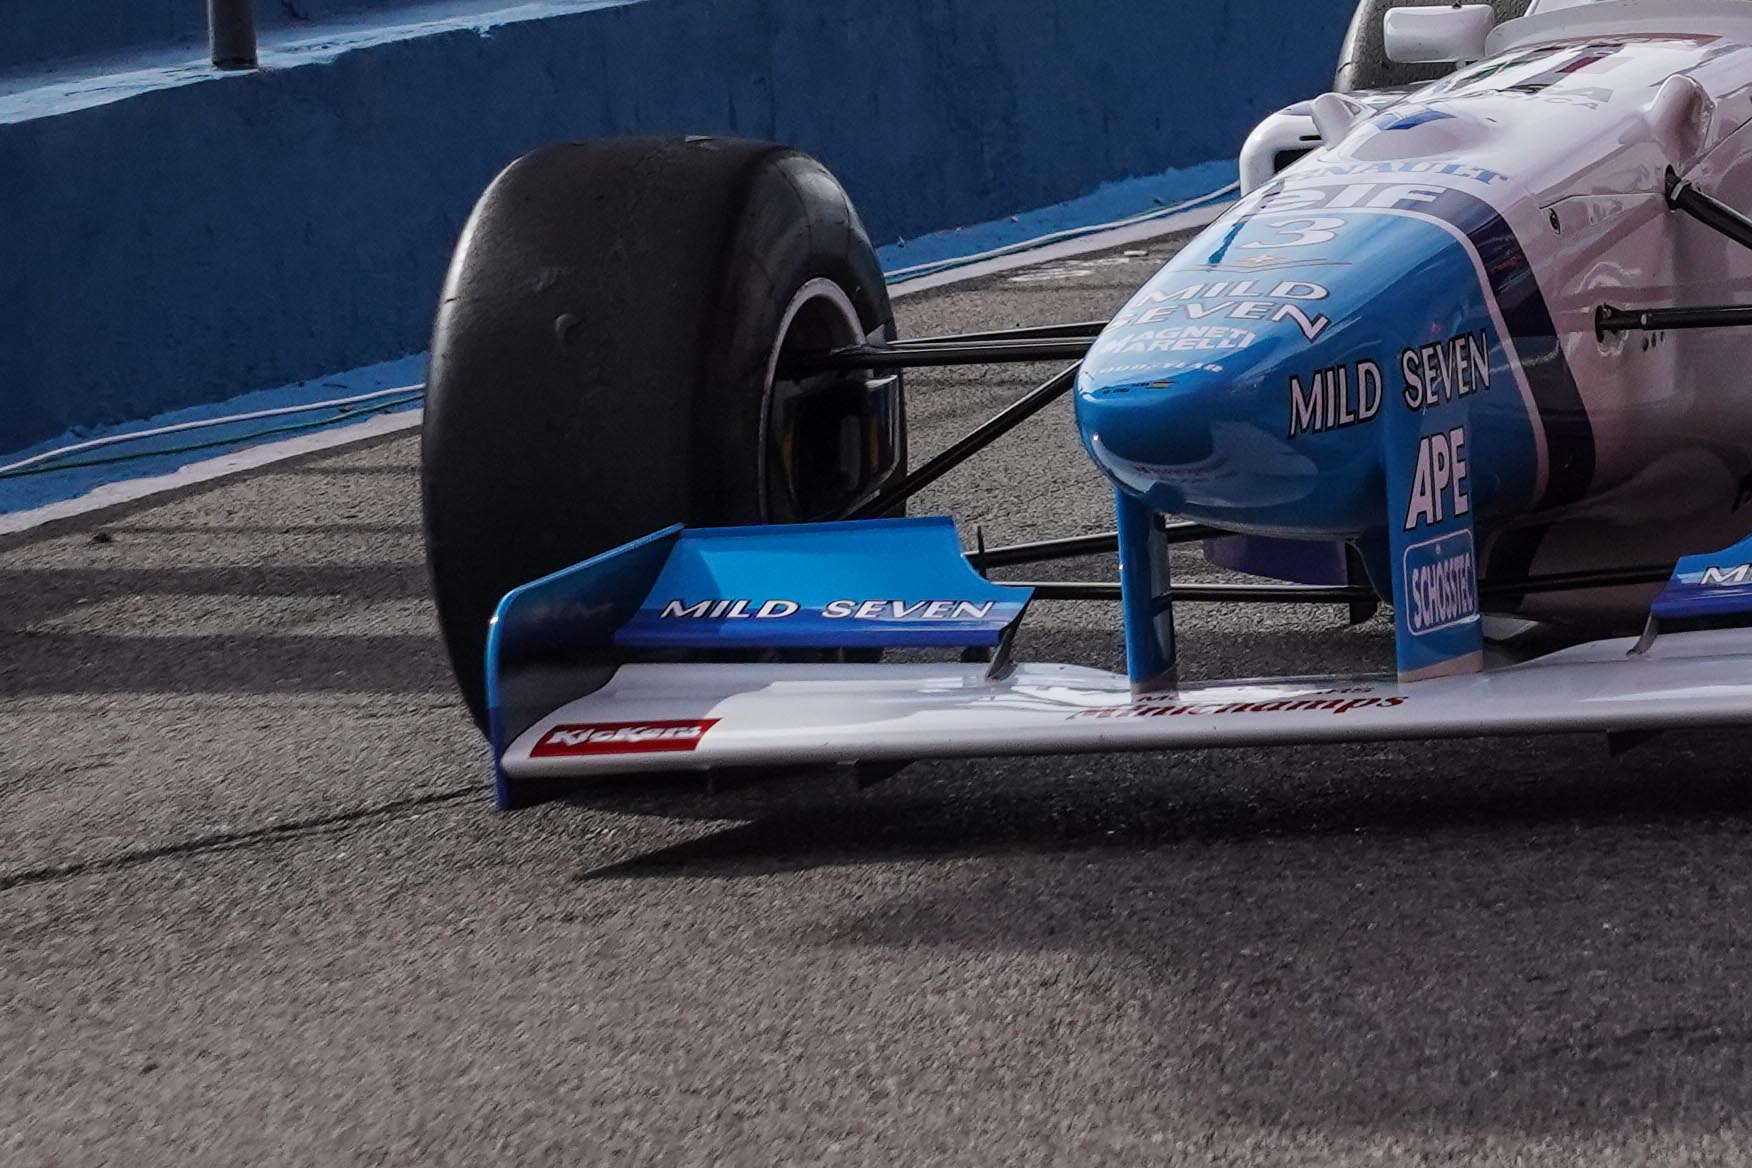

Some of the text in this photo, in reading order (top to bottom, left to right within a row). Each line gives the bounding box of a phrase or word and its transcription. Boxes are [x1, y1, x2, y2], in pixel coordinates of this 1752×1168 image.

[1134, 281, 1330, 308] MILD
[1288, 330, 1490, 438] MILD SEVEN
[1404, 425, 1470, 532] APE
[659, 599, 997, 620] MILD SEVEN
